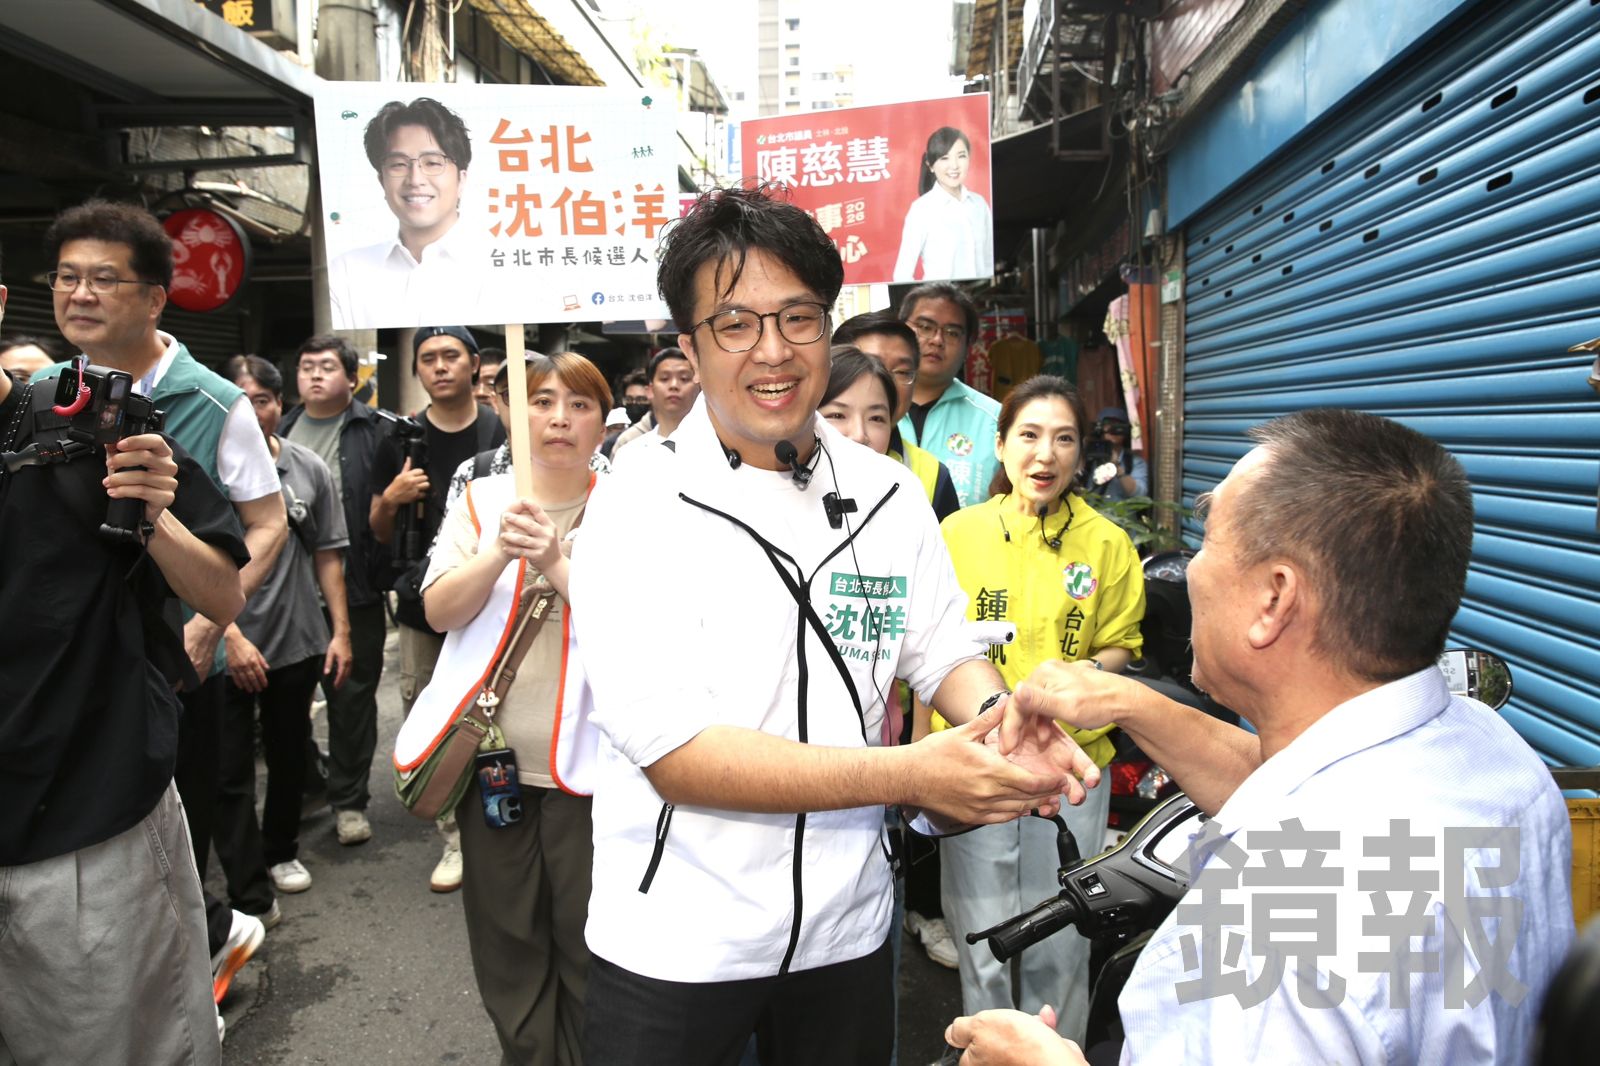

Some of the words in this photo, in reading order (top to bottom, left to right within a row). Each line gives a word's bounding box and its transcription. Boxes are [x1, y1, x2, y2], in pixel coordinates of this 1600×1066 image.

[489, 118, 594, 173] 台北
[757, 136, 892, 188] 陳慈慧
[488, 184, 669, 239] 沈伯洋
[805, 203, 843, 233] 事
[846, 201, 865, 214] 20
[846, 211, 865, 225] 26
[490, 246, 649, 267] 台北市長候選人
[833, 235, 868, 264] 心
[608, 294, 625, 303] 台北
[1059, 606, 1085, 661] 台北
[837, 645, 870, 661] UMA
